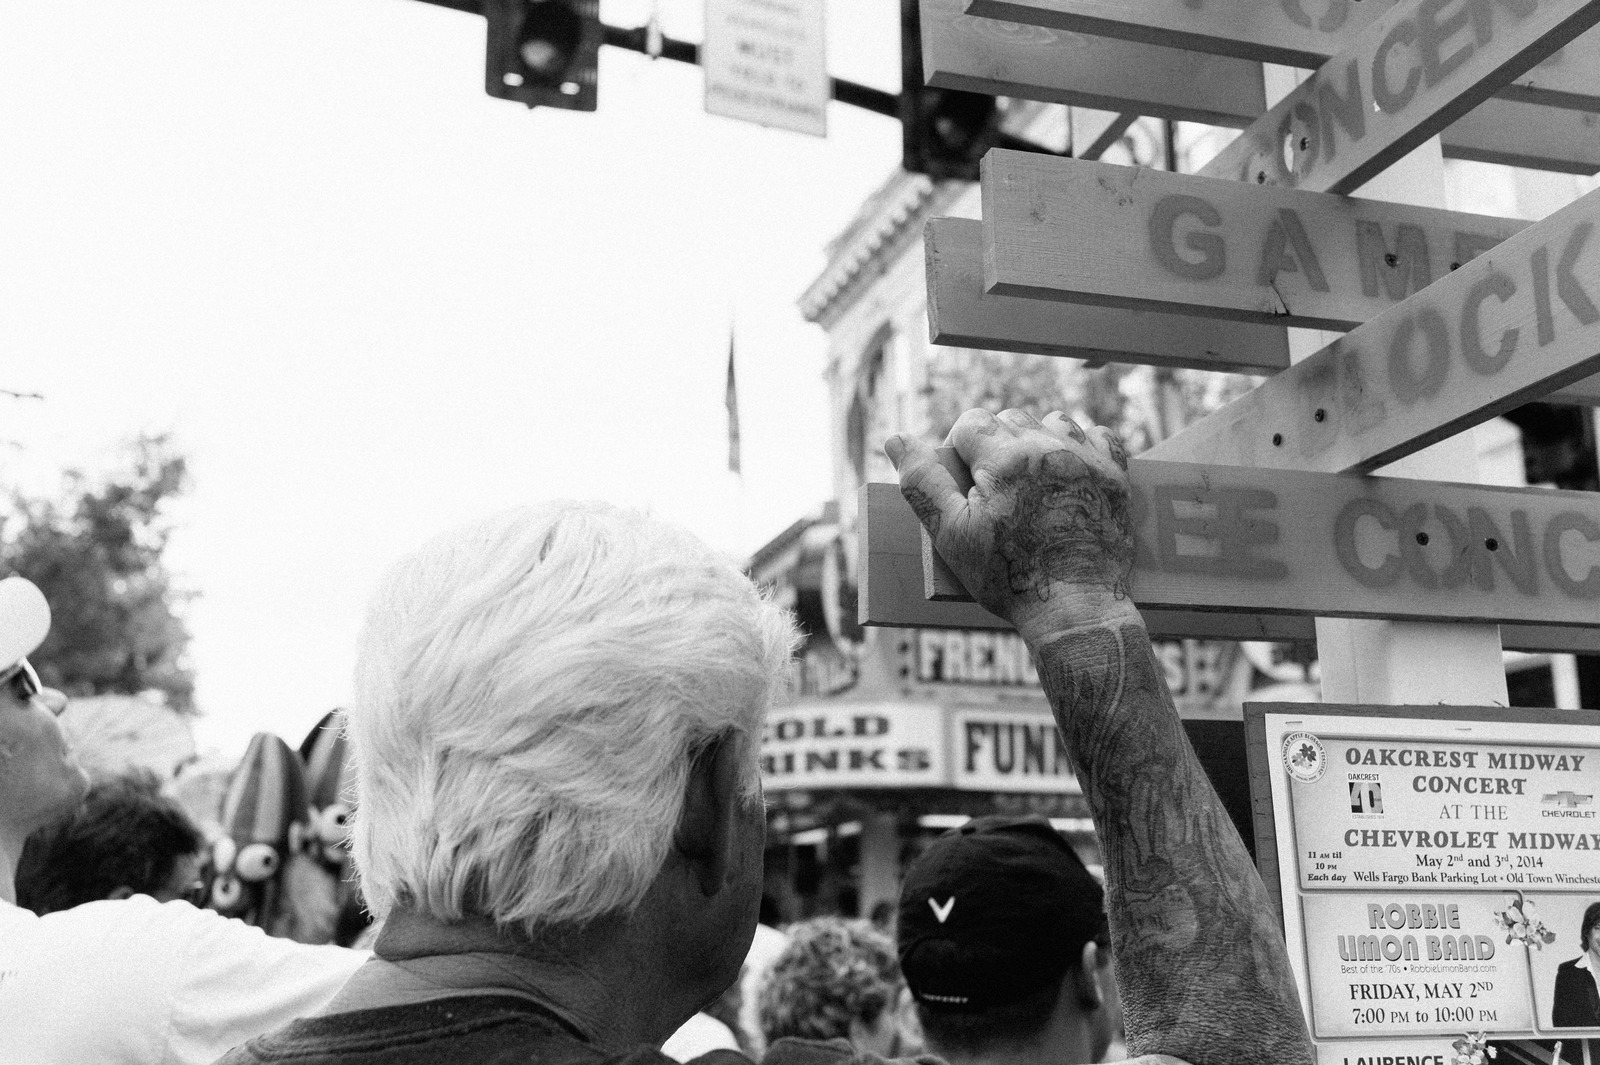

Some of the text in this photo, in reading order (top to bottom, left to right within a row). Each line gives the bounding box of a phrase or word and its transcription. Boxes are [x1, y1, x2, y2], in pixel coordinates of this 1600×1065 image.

[1335, 500, 1600, 598] CONC
[762, 717, 889, 742] OLD
[762, 751, 930, 776] INKS
[1345, 748, 1586, 772] OAKCREST MIDWAY
[1347, 772, 1380, 781] OAKCREST
[1412, 775, 1527, 795] CONCERT
[1439, 804, 1509, 820] AT THE
[1541, 810, 1597, 819] CHEVROLET
[1344, 829, 1499, 849] CHEVROLET
[1307, 851, 1317, 859] 11
[1332, 851, 1342, 859] til
[1415, 854, 1443, 869] May
[1447, 853, 1464, 867] 2nd
[1467, 855, 1491, 868] and
[1516, 855, 1544, 868] 2014
[1315, 862, 1325, 870] 10
[1307, 873, 1347, 883] Each day
[1353, 871, 1380, 883] Wells
[1382, 871, 1409, 884] Fargo
[1411, 871, 1438, 883] Bank
[1440, 872, 1479, 885] Parking
[1481, 872, 1498, 883] Lot
[1506, 872, 1524, 884] Old
[1525, 873, 1553, 884] Town
[1366, 902, 1461, 930] ROBBIE
[1337, 934, 1496, 962] LIMON BAND
[1341, 965, 1358, 974] Best
[1360, 964, 1369, 974] of
[1370, 964, 1384, 974] the
[1410, 964, 1498, 974] RobbieLimonBand.com
[1349, 981, 1494, 1002] FRIDAY, MAY 2ND
[1352, 1006, 1498, 1024] 7:00 PM to 10:00 PM
